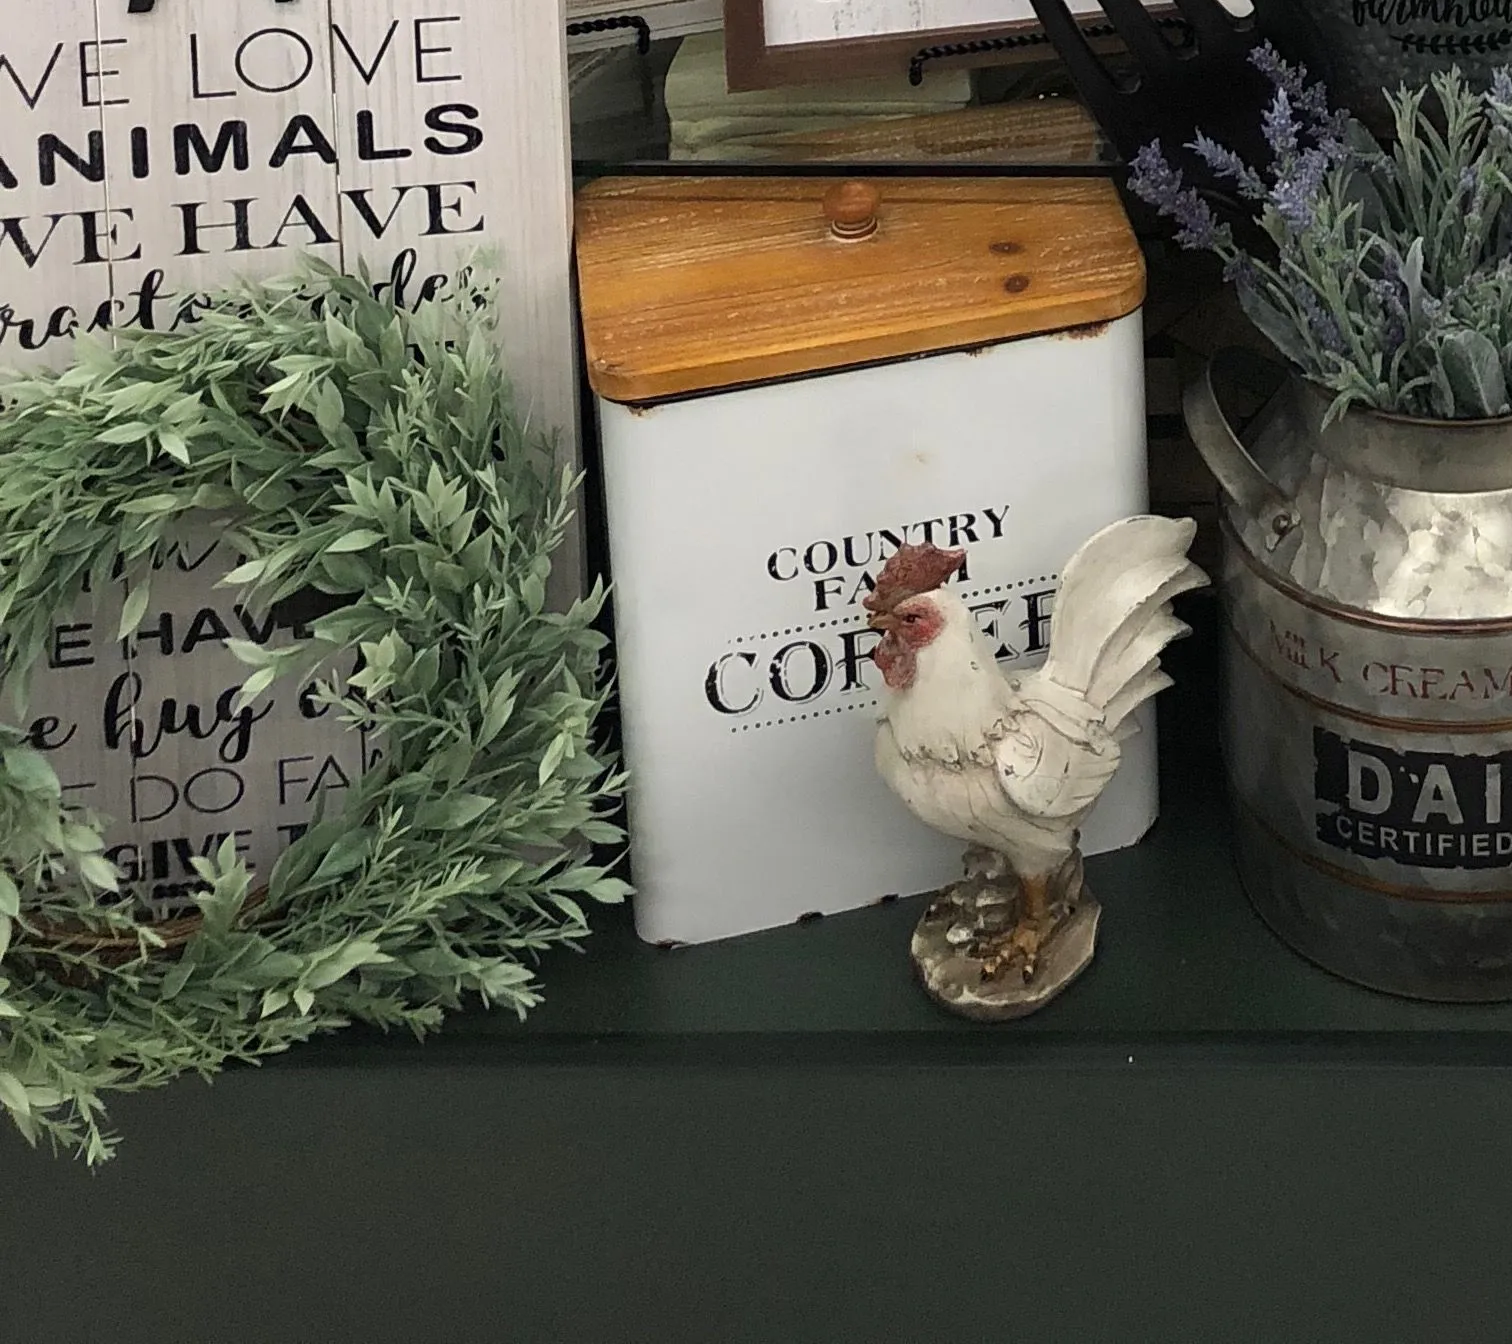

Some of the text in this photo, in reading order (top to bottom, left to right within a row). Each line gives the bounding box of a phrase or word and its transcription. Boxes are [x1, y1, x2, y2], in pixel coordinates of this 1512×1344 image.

[190, 16, 463, 99] LOVE
[0, 102, 485, 190] NIMALS
[173, 179, 485, 258] HAVE
[766, 505, 1011, 583] COUNTRY
[1268, 617, 1344, 685] MILK
[104, 670, 275, 764] hug
[130, 766, 246, 824] DO
